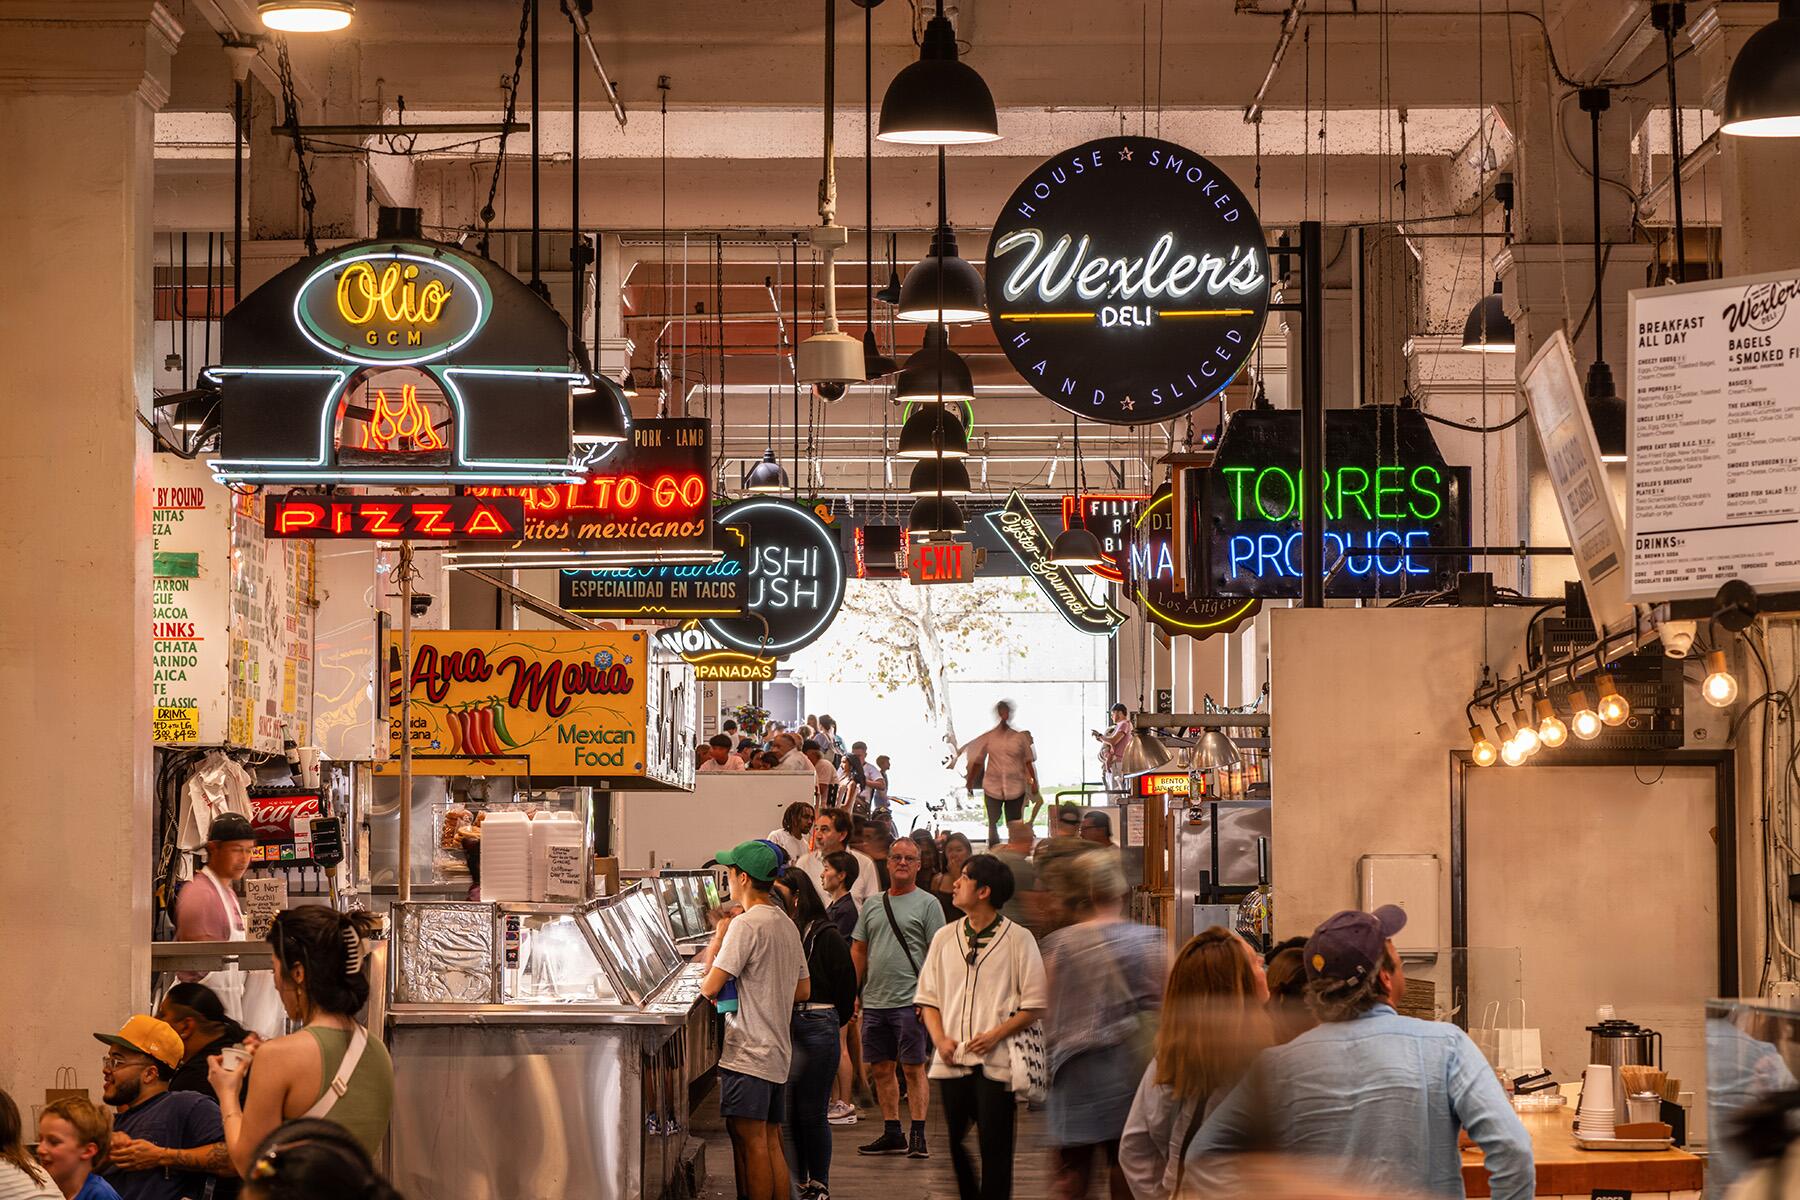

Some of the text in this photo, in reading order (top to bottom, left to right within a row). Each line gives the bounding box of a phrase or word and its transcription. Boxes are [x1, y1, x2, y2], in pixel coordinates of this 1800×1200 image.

[1018, 149, 1239, 223] HOUSE SMOKED
[993, 228, 1264, 302] Wexler's
[335, 261, 454, 326] Olio
[1101, 306, 1151, 327] DELI
[1639, 316, 1704, 334] BREAKFAST
[366, 330, 422, 346] GCM
[1639, 332, 1687, 348] ALL DAY
[1729, 336, 1771, 351] BAGELS
[1736, 349, 1784, 364] SMOKED
[1012, 329, 1242, 405] HAND SLICED
[635, 428, 704, 447] PORK LAMB
[1637, 444, 1652, 452] UPPER
[1663, 477, 1693, 486] BREAKFAST
[157, 487, 204, 507] BY POUND
[593, 475, 641, 509] TO
[653, 475, 704, 509] GO
[274, 502, 512, 535] PIZZA
[577, 516, 705, 539] mexicanos
[1021, 517, 1039, 537] The
[1636, 536, 1676, 550] DRINKS
[919, 545, 964, 580] EXIT
[571, 580, 736, 599] ESPECIALIDAD EN TACOS
[1158, 591, 1181, 611] Los
[154, 641, 198, 653] CHATA
[154, 669, 187, 681] AICA
[389, 643, 635, 718] Ana Maria
[158, 697, 198, 709] CLASSIC
[157, 708, 187, 720] DRINK
[557, 723, 636, 745] Mexican
[574, 747, 625, 767] Food
[1160, 777, 1184, 785] BENTO
